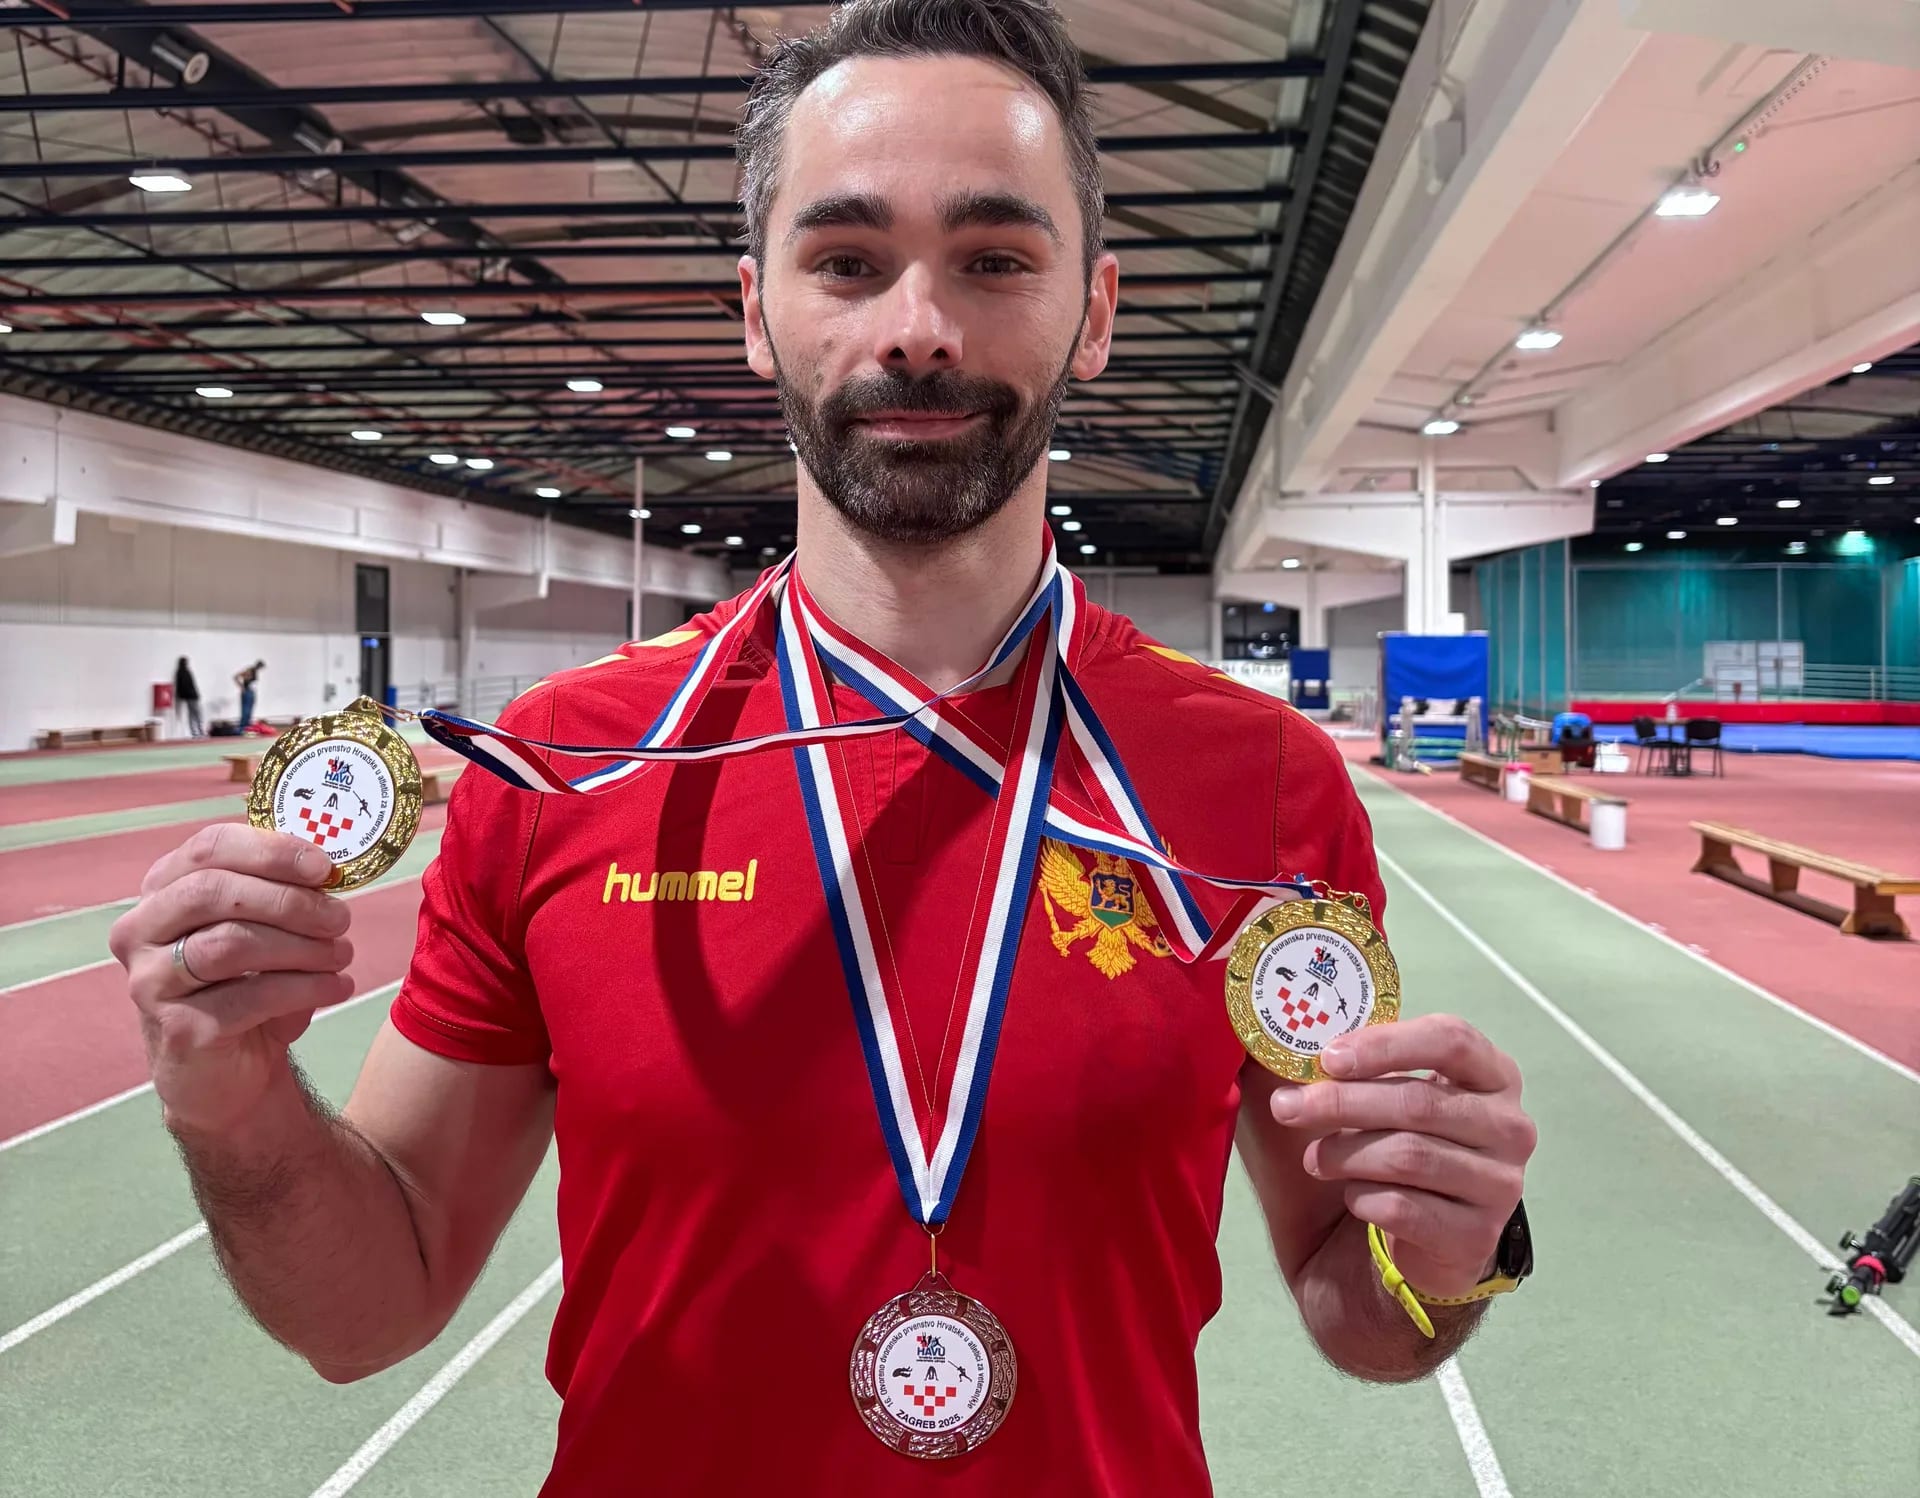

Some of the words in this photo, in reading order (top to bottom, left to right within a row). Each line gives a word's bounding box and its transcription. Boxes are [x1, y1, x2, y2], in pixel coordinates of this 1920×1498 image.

[276, 780, 289, 814] Otvoreno
[286, 751, 316, 780] dvoransko
[316, 744, 352, 757] prvenstvo
[352, 746, 378, 770] Hrvatske
[377, 775, 390, 799] atletici
[324, 769, 354, 786] HAVU
[602, 858, 759, 904] hummel
[1255, 954, 1273, 986] Otvoreno
[1271, 932, 1305, 956] dvoransko
[1305, 932, 1340, 947] prvenstvo
[1339, 943, 1363, 973] Hrvatske
[1360, 979, 1370, 1005] atletici
[1308, 957, 1338, 980] HAVU
[1260, 1007, 1294, 1045] ZAGREB
[1295, 1040, 1323, 1051] 2025.
[902, 1320, 935, 1336] prvenstvo
[936, 1320, 965, 1339] Hrvatske
[880, 1331, 903, 1364] dvoransko
[917, 1346, 946, 1357] HAVU
[967, 1340, 984, 1363] atletici
[878, 1363, 888, 1396] Otvoreno
[895, 1408, 936, 1429] ZAGREB
[938, 1412, 964, 1429] 2025.
